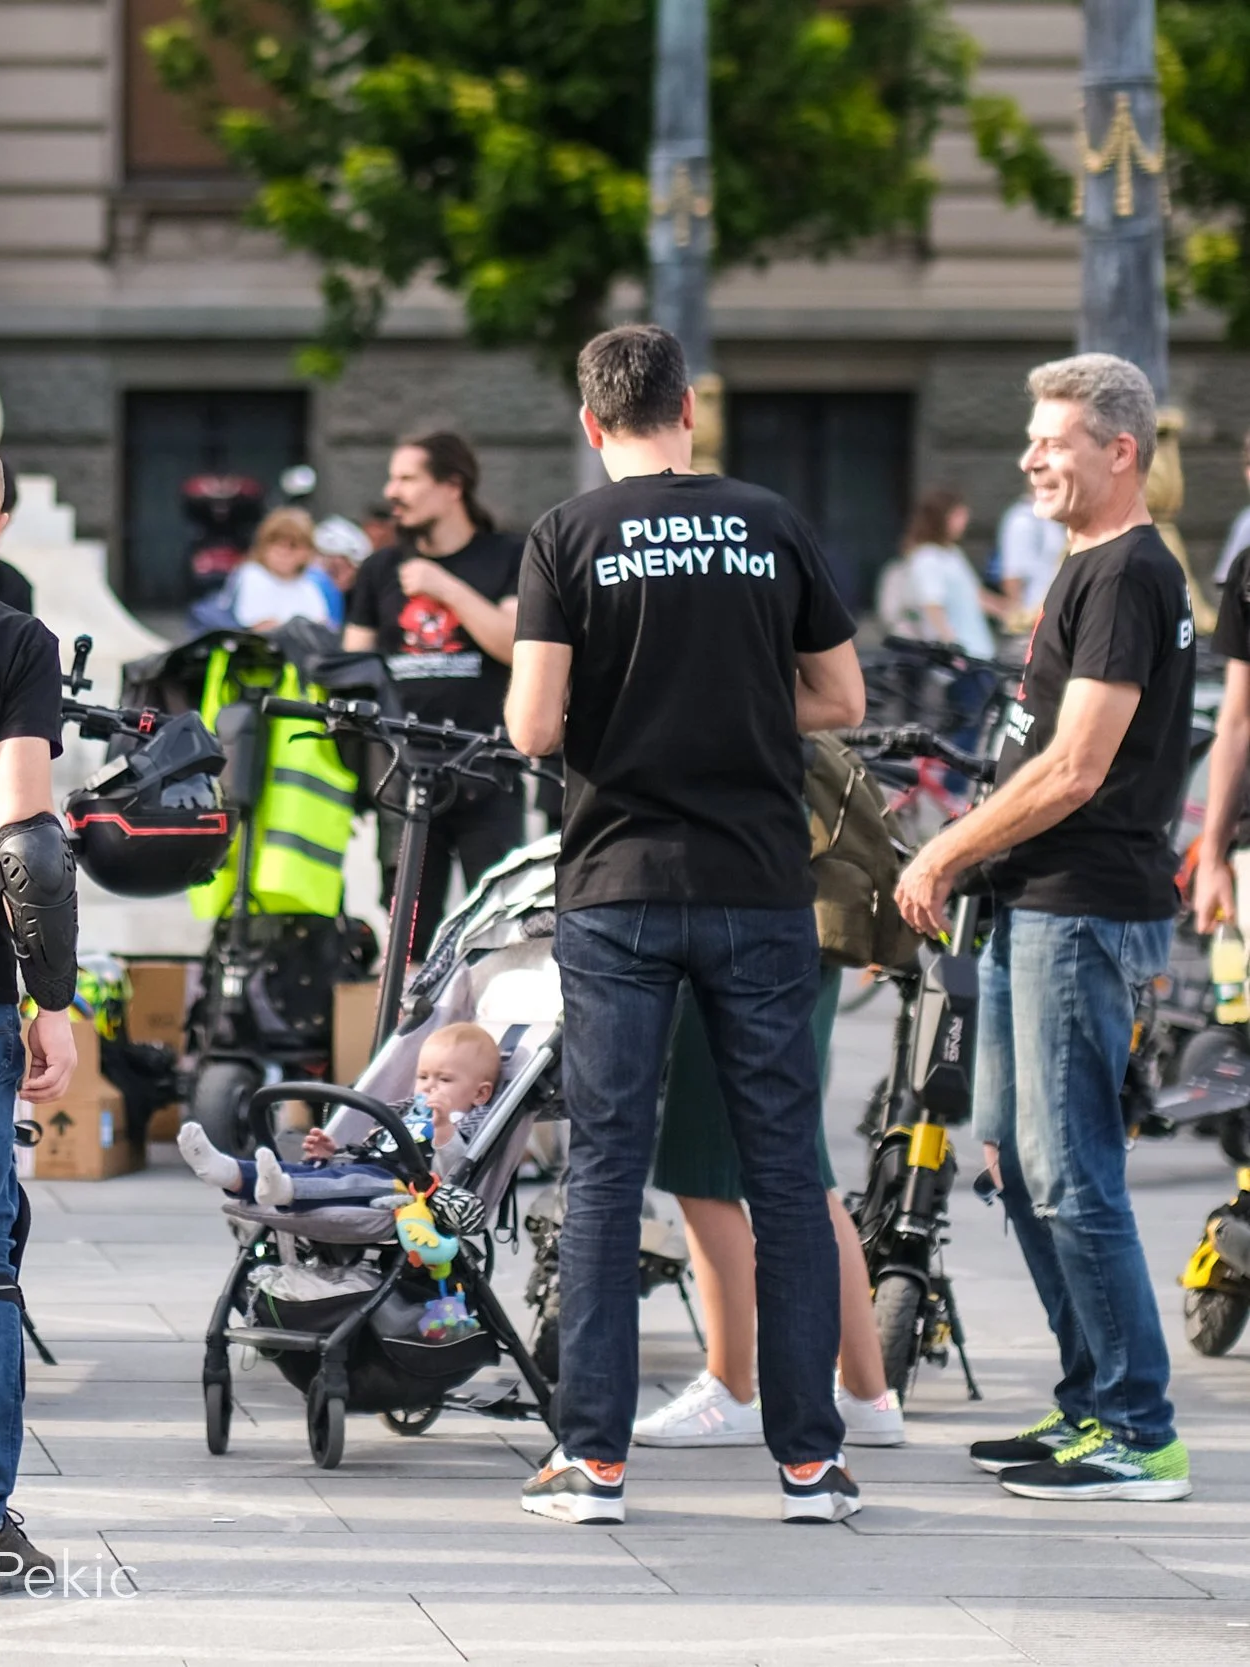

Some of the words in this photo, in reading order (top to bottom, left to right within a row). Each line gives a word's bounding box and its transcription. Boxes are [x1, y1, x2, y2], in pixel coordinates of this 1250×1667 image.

[619, 515, 749, 548] PUBLIC
[595, 546, 716, 587] ENEMY
[723, 546, 776, 580] No1
